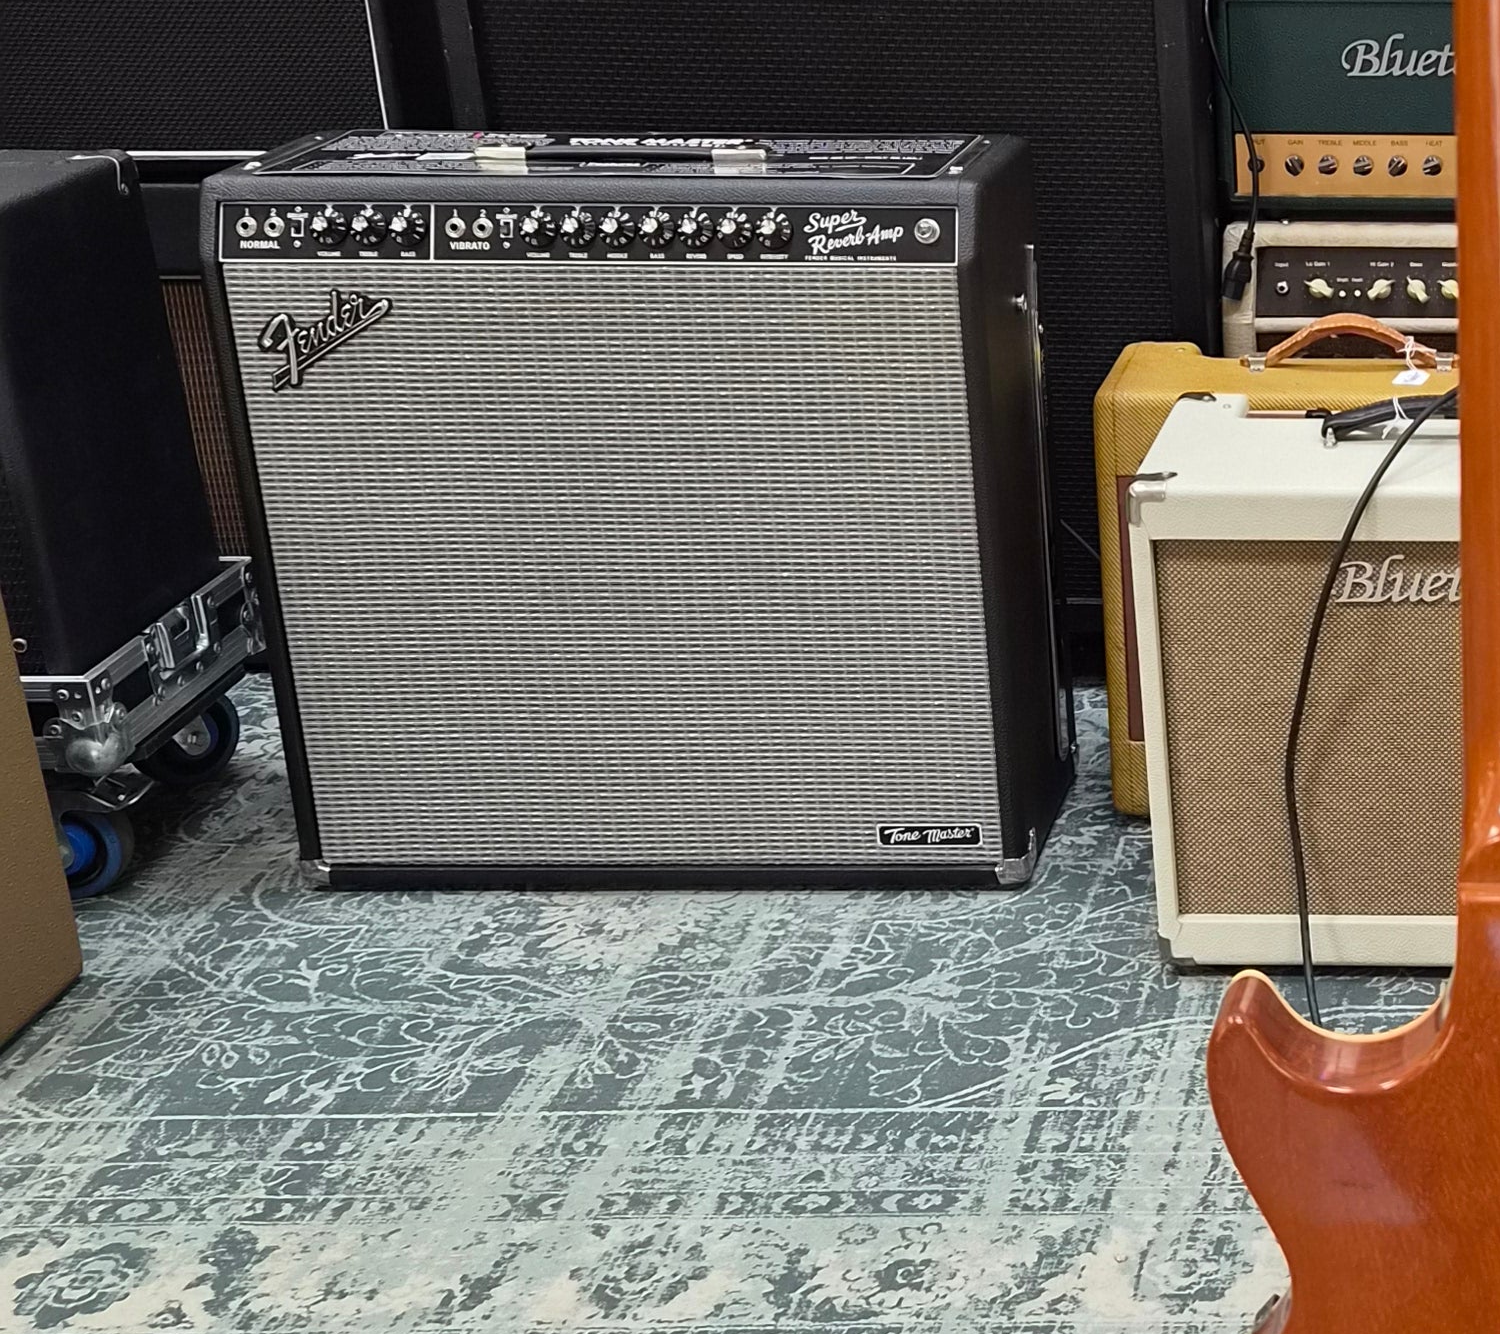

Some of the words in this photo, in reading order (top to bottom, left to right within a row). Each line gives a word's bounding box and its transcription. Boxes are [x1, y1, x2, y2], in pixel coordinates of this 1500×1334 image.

[1341, 33, 1457, 77] Bluet
[803, 209, 867, 233] Super
[240, 240, 281, 249] NORMAL
[449, 241, 491, 251] VIBRATO
[808, 225, 904, 255] Reverb-Amp
[262, 290, 389, 388] Fender
[884, 828, 921, 844] Tone
[922, 827, 972, 844] Master
